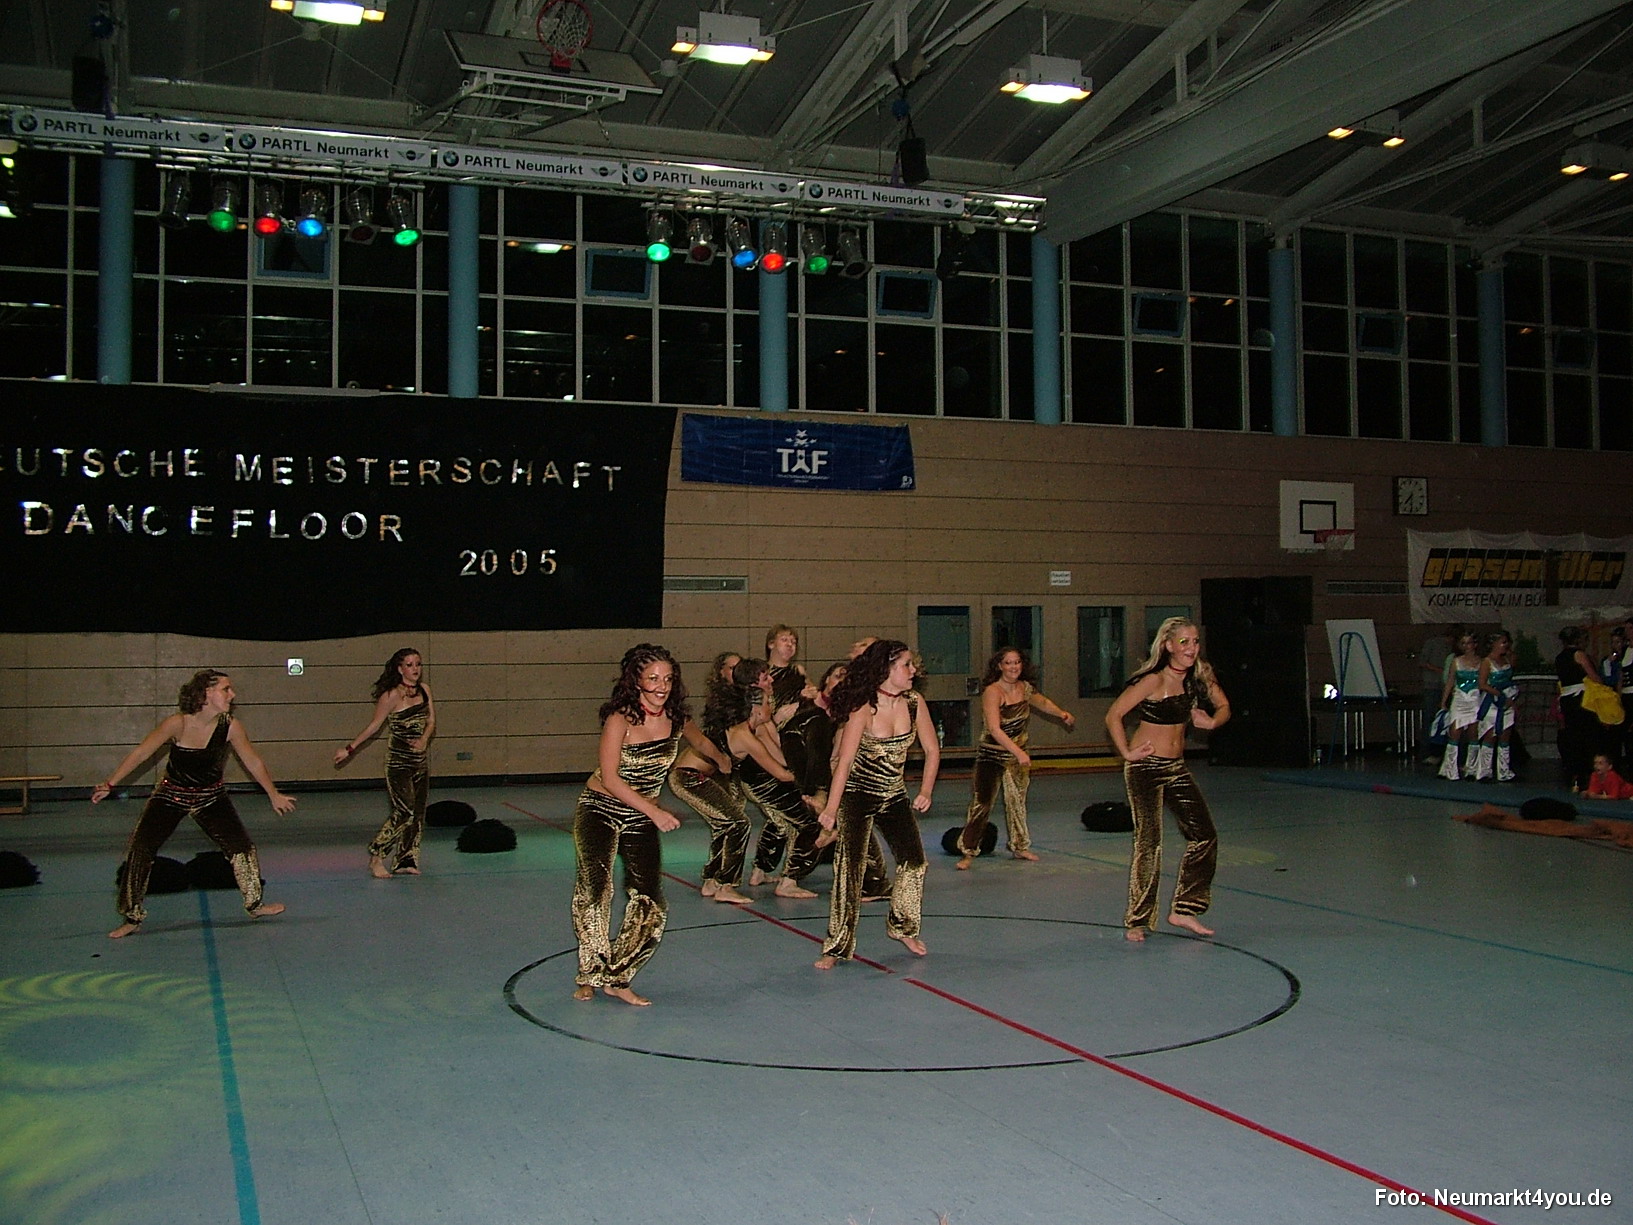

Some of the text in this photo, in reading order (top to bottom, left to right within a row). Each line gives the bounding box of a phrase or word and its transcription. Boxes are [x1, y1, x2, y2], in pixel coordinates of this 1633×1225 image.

[44, 118, 181, 142] PARTL Neumarkt
[262, 137, 389, 158] PARTL Neumarkt
[464, 155, 583, 175] PARTL Neumarkt
[653, 171, 763, 191] PARTL Neumarkt
[828, 187, 930, 207] PARTL Neumarkt
[0, 448, 622, 491] UTSCHE MEISTERSCHAFT
[22, 501, 403, 542] DANCEFLOOR
[459, 549, 557, 576] 2005
[1421, 548, 1626, 589] graseniller
[1427, 593, 1505, 607] KOMPETENZ
[1508, 593, 1522, 607] IM
